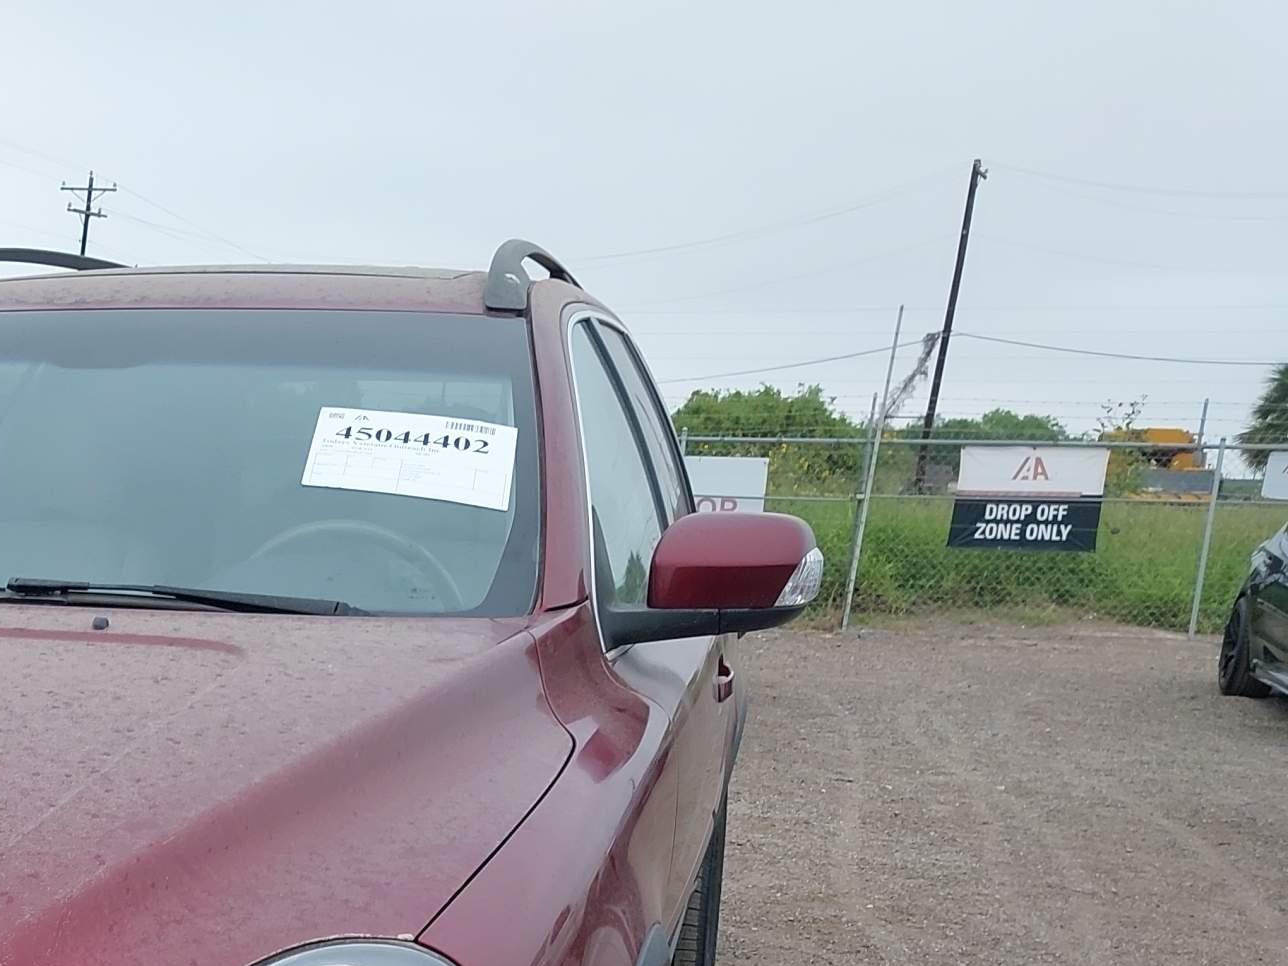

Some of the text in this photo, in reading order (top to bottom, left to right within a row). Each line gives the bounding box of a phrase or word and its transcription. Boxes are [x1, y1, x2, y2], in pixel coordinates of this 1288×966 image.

[335, 426, 489, 454] 45044402
[984, 504, 1069, 522] DROP OFF
[974, 522, 1072, 542] ZONE ONLY
